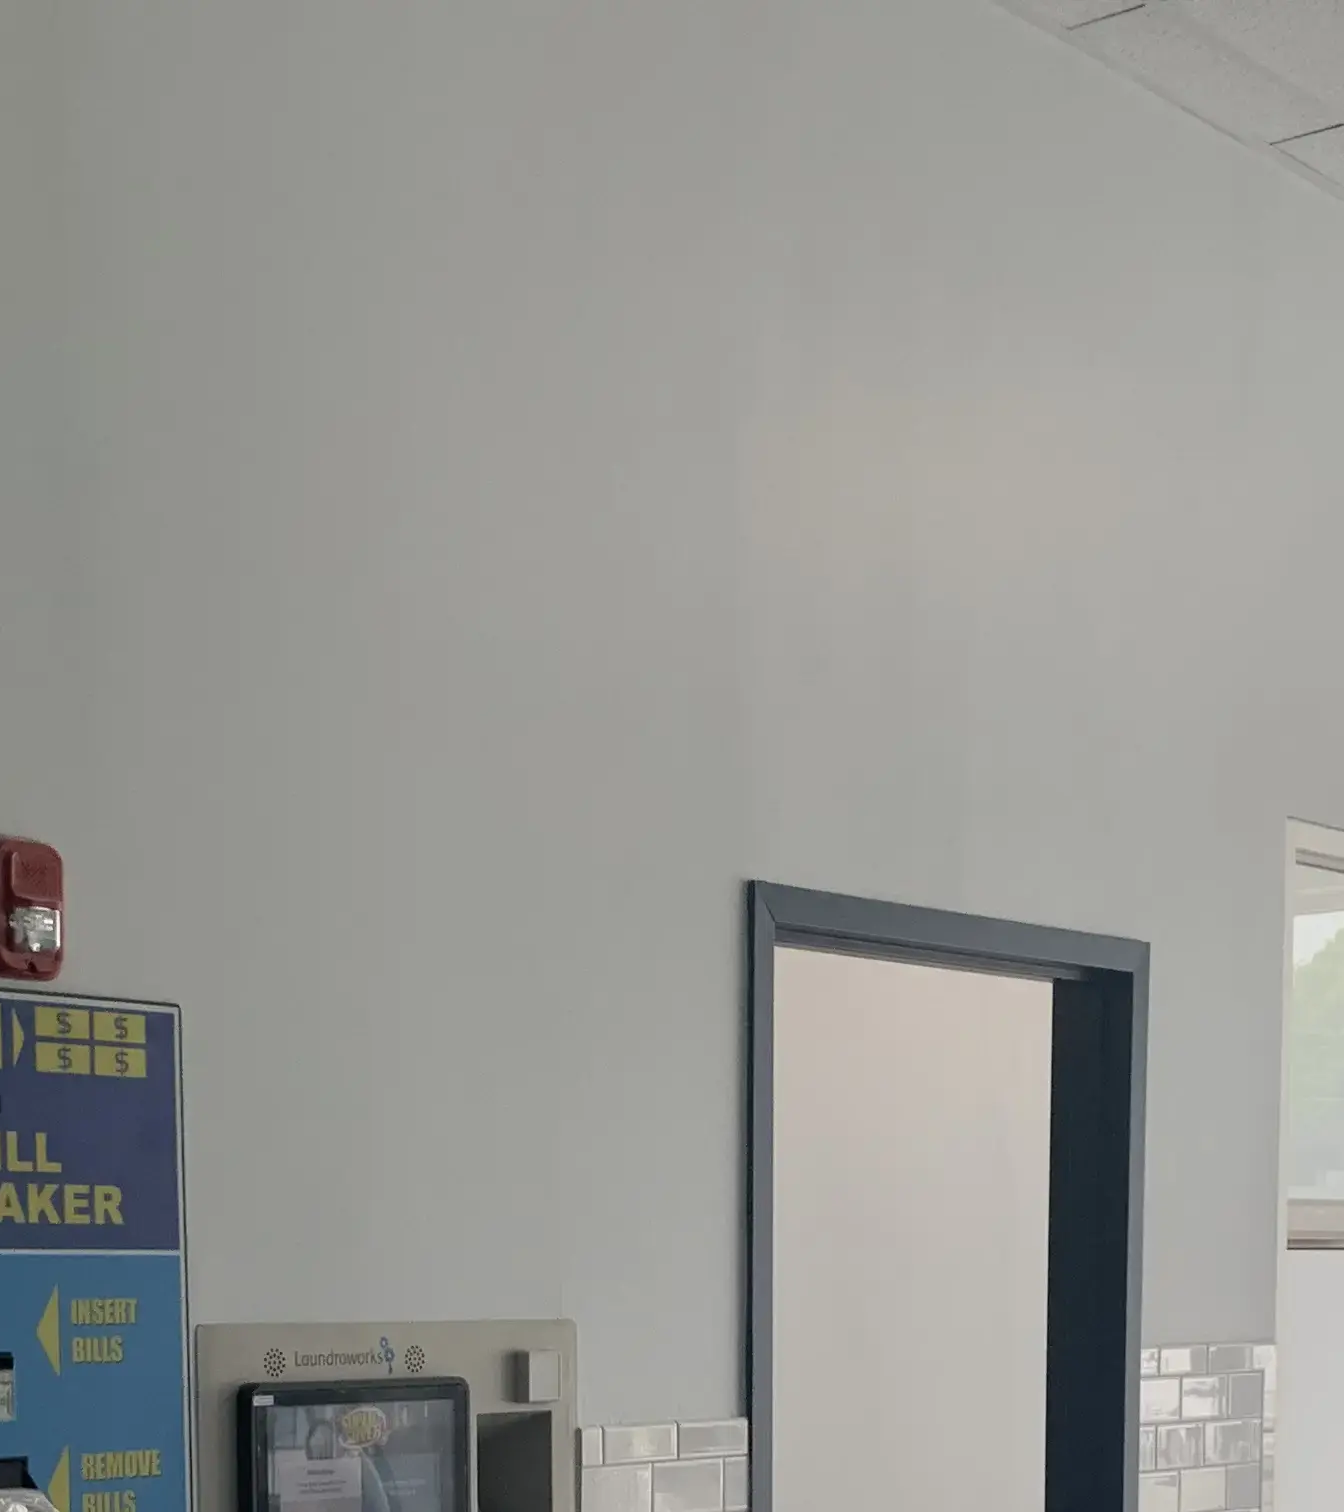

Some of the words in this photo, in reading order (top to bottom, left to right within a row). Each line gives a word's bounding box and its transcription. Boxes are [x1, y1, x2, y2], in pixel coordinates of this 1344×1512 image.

[70, 1298, 138, 1325] INSERT
[71, 1336, 125, 1364] BILLS
[294, 1347, 384, 1368] Laundroworks
[81, 1449, 162, 1481] REMOVE
